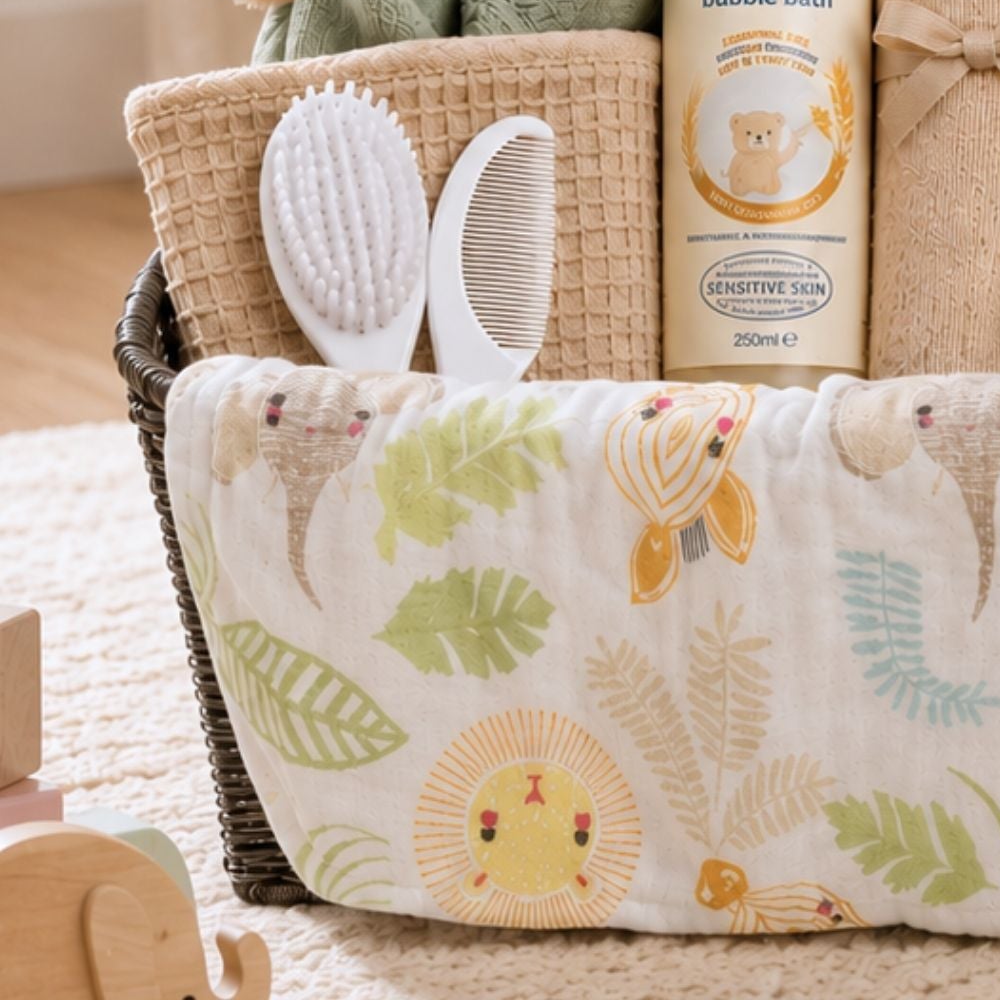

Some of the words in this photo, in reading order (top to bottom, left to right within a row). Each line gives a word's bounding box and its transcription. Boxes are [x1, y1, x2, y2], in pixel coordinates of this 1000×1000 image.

[707, 281, 785, 296] SENSITIVE
[791, 281, 826, 296] SKIN
[733, 332, 779, 347] 250ml
